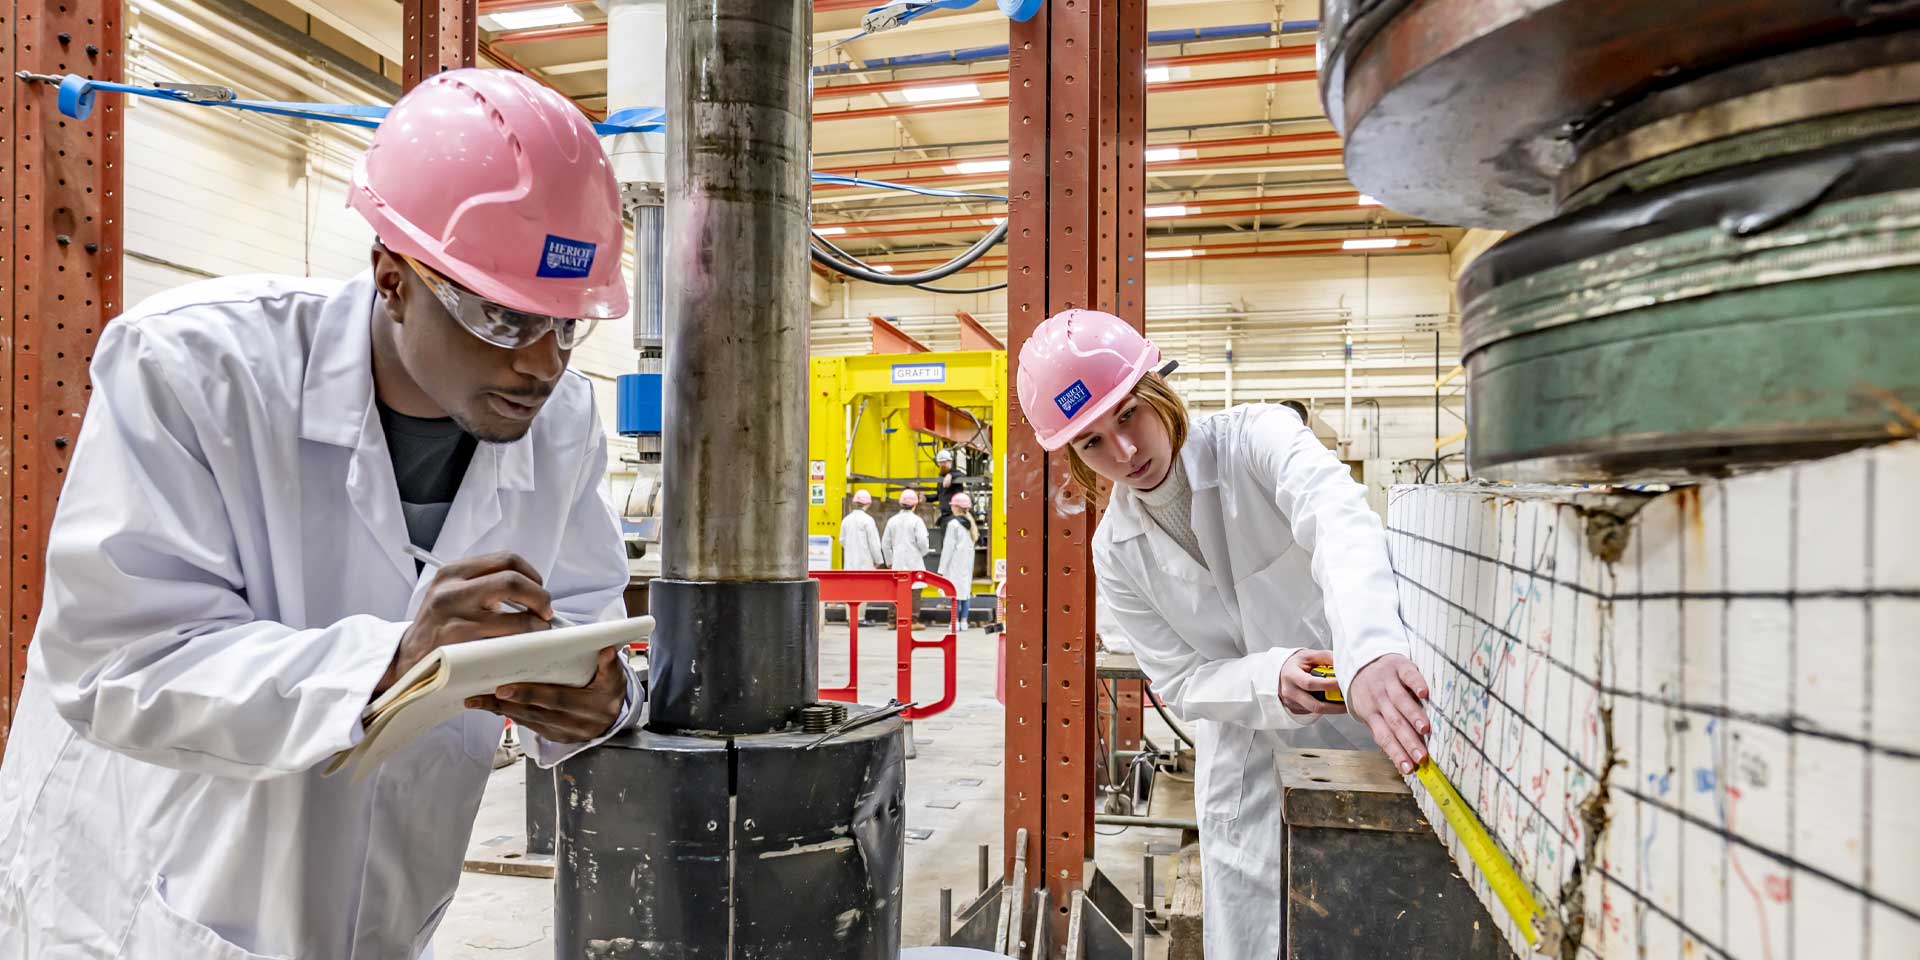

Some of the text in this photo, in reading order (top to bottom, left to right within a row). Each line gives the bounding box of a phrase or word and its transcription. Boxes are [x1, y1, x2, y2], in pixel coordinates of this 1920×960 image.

[549, 241, 592, 258] HERIOT
[560, 254, 590, 268] WATT
[897, 368, 931, 378] GRAFT
[1057, 383, 1081, 405] HERIOT
[1067, 388, 1085, 405] WATT
